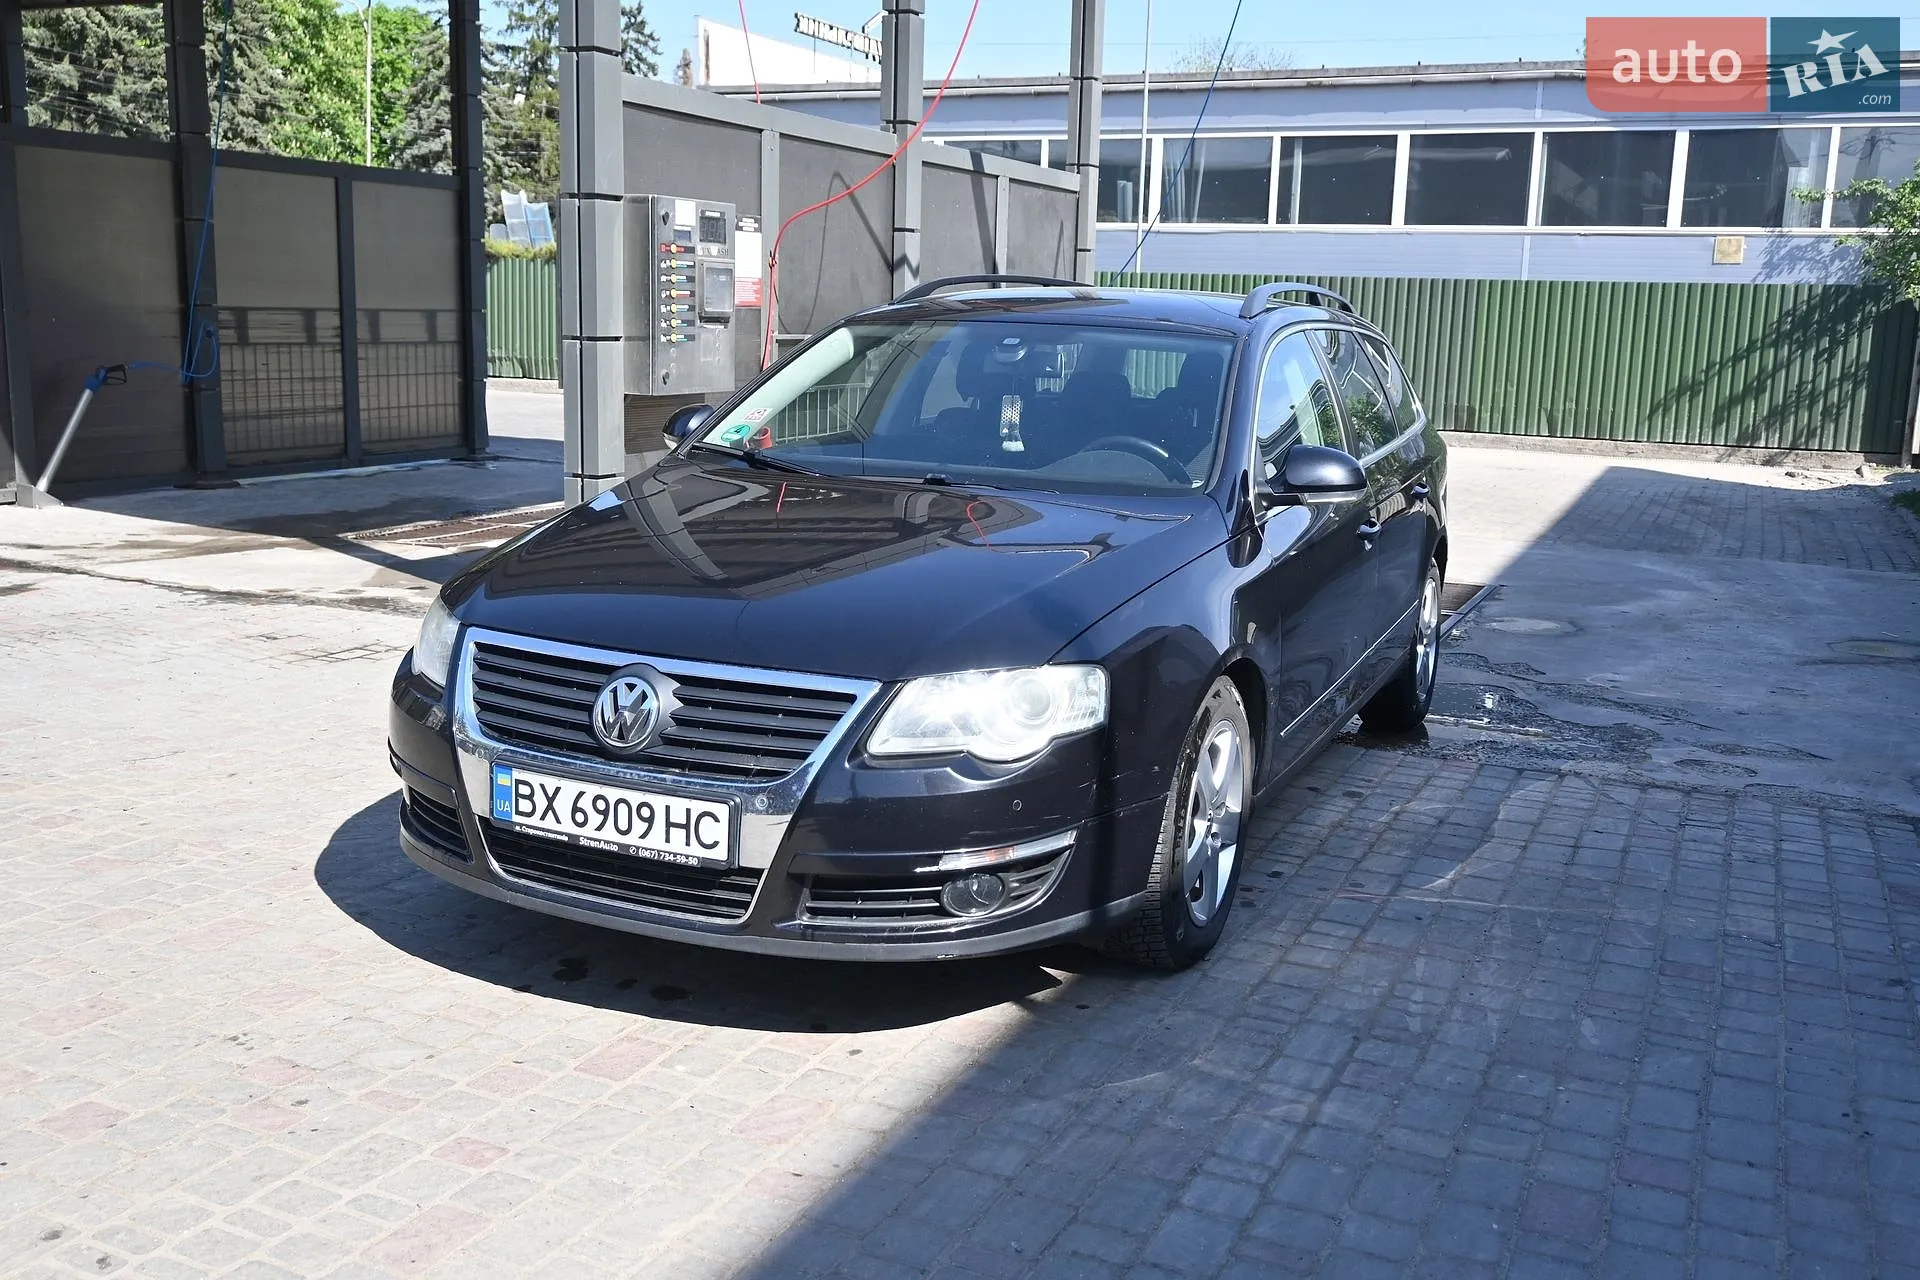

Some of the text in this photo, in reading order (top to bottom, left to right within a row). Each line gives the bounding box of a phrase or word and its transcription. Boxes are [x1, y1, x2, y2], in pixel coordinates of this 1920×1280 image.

[594, 676, 660, 747] VW
[496, 799, 511, 813] UA
[515, 779, 721, 850] BX 6909 HC
[579, 836, 619, 852] StrenAuto
[638, 846, 699, 866] (067) 734-59-50
